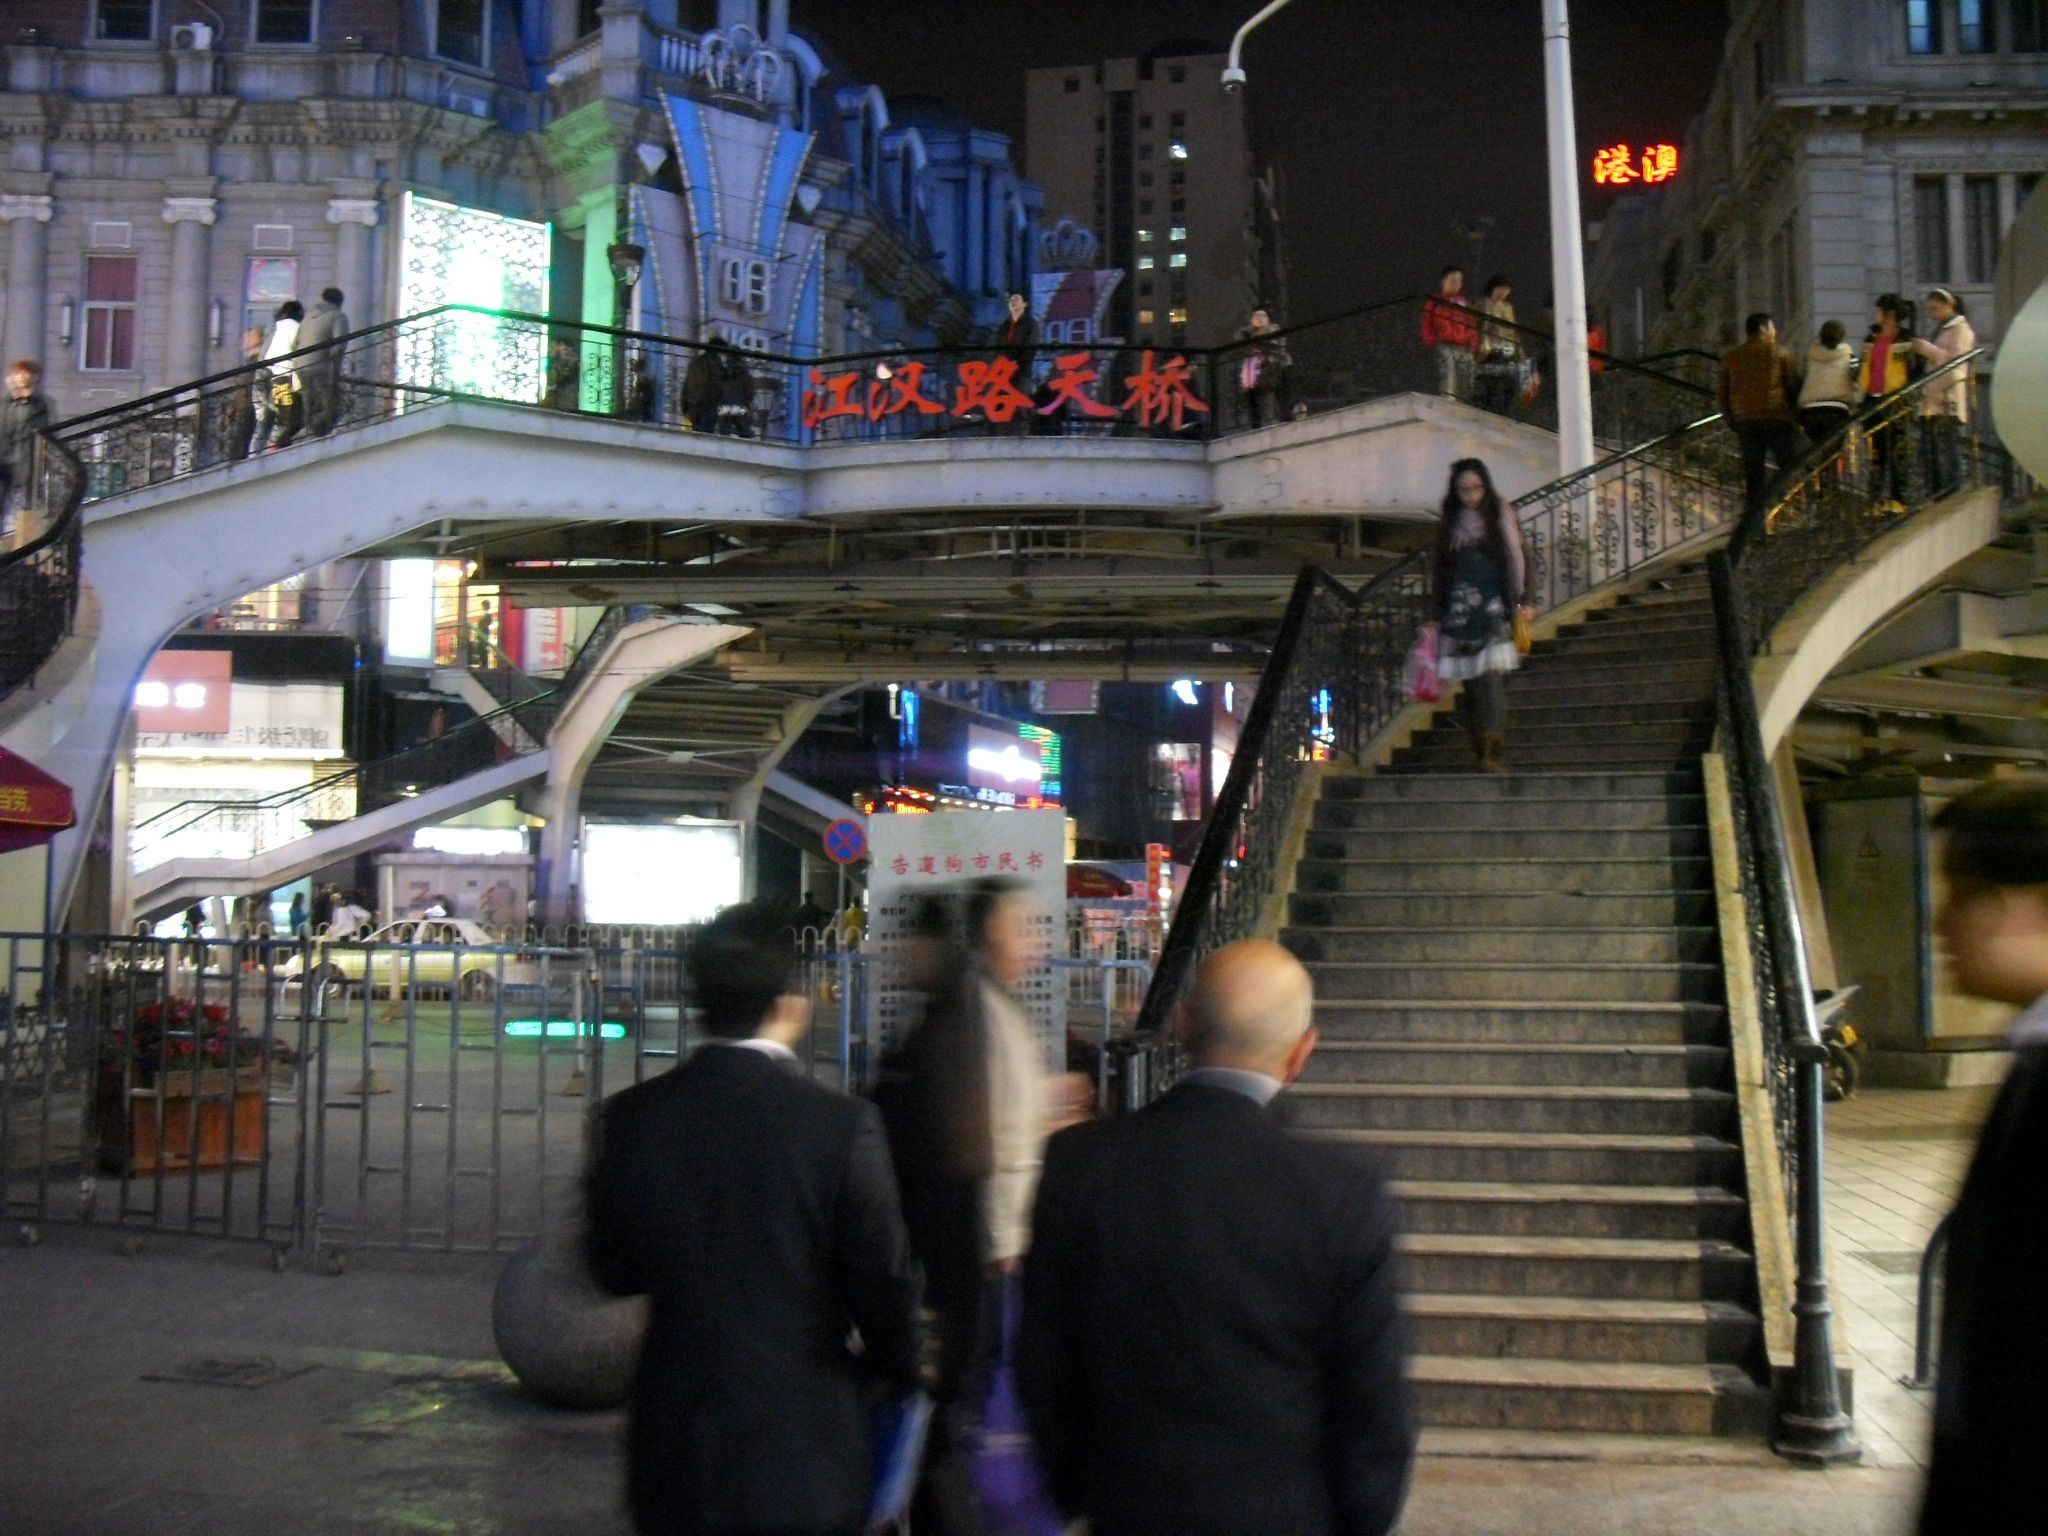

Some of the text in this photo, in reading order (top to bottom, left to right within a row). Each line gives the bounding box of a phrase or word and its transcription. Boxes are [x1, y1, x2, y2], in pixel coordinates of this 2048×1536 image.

[1594, 143, 1678, 184] 港澳
[803, 349, 1210, 432] 江汉路天桥
